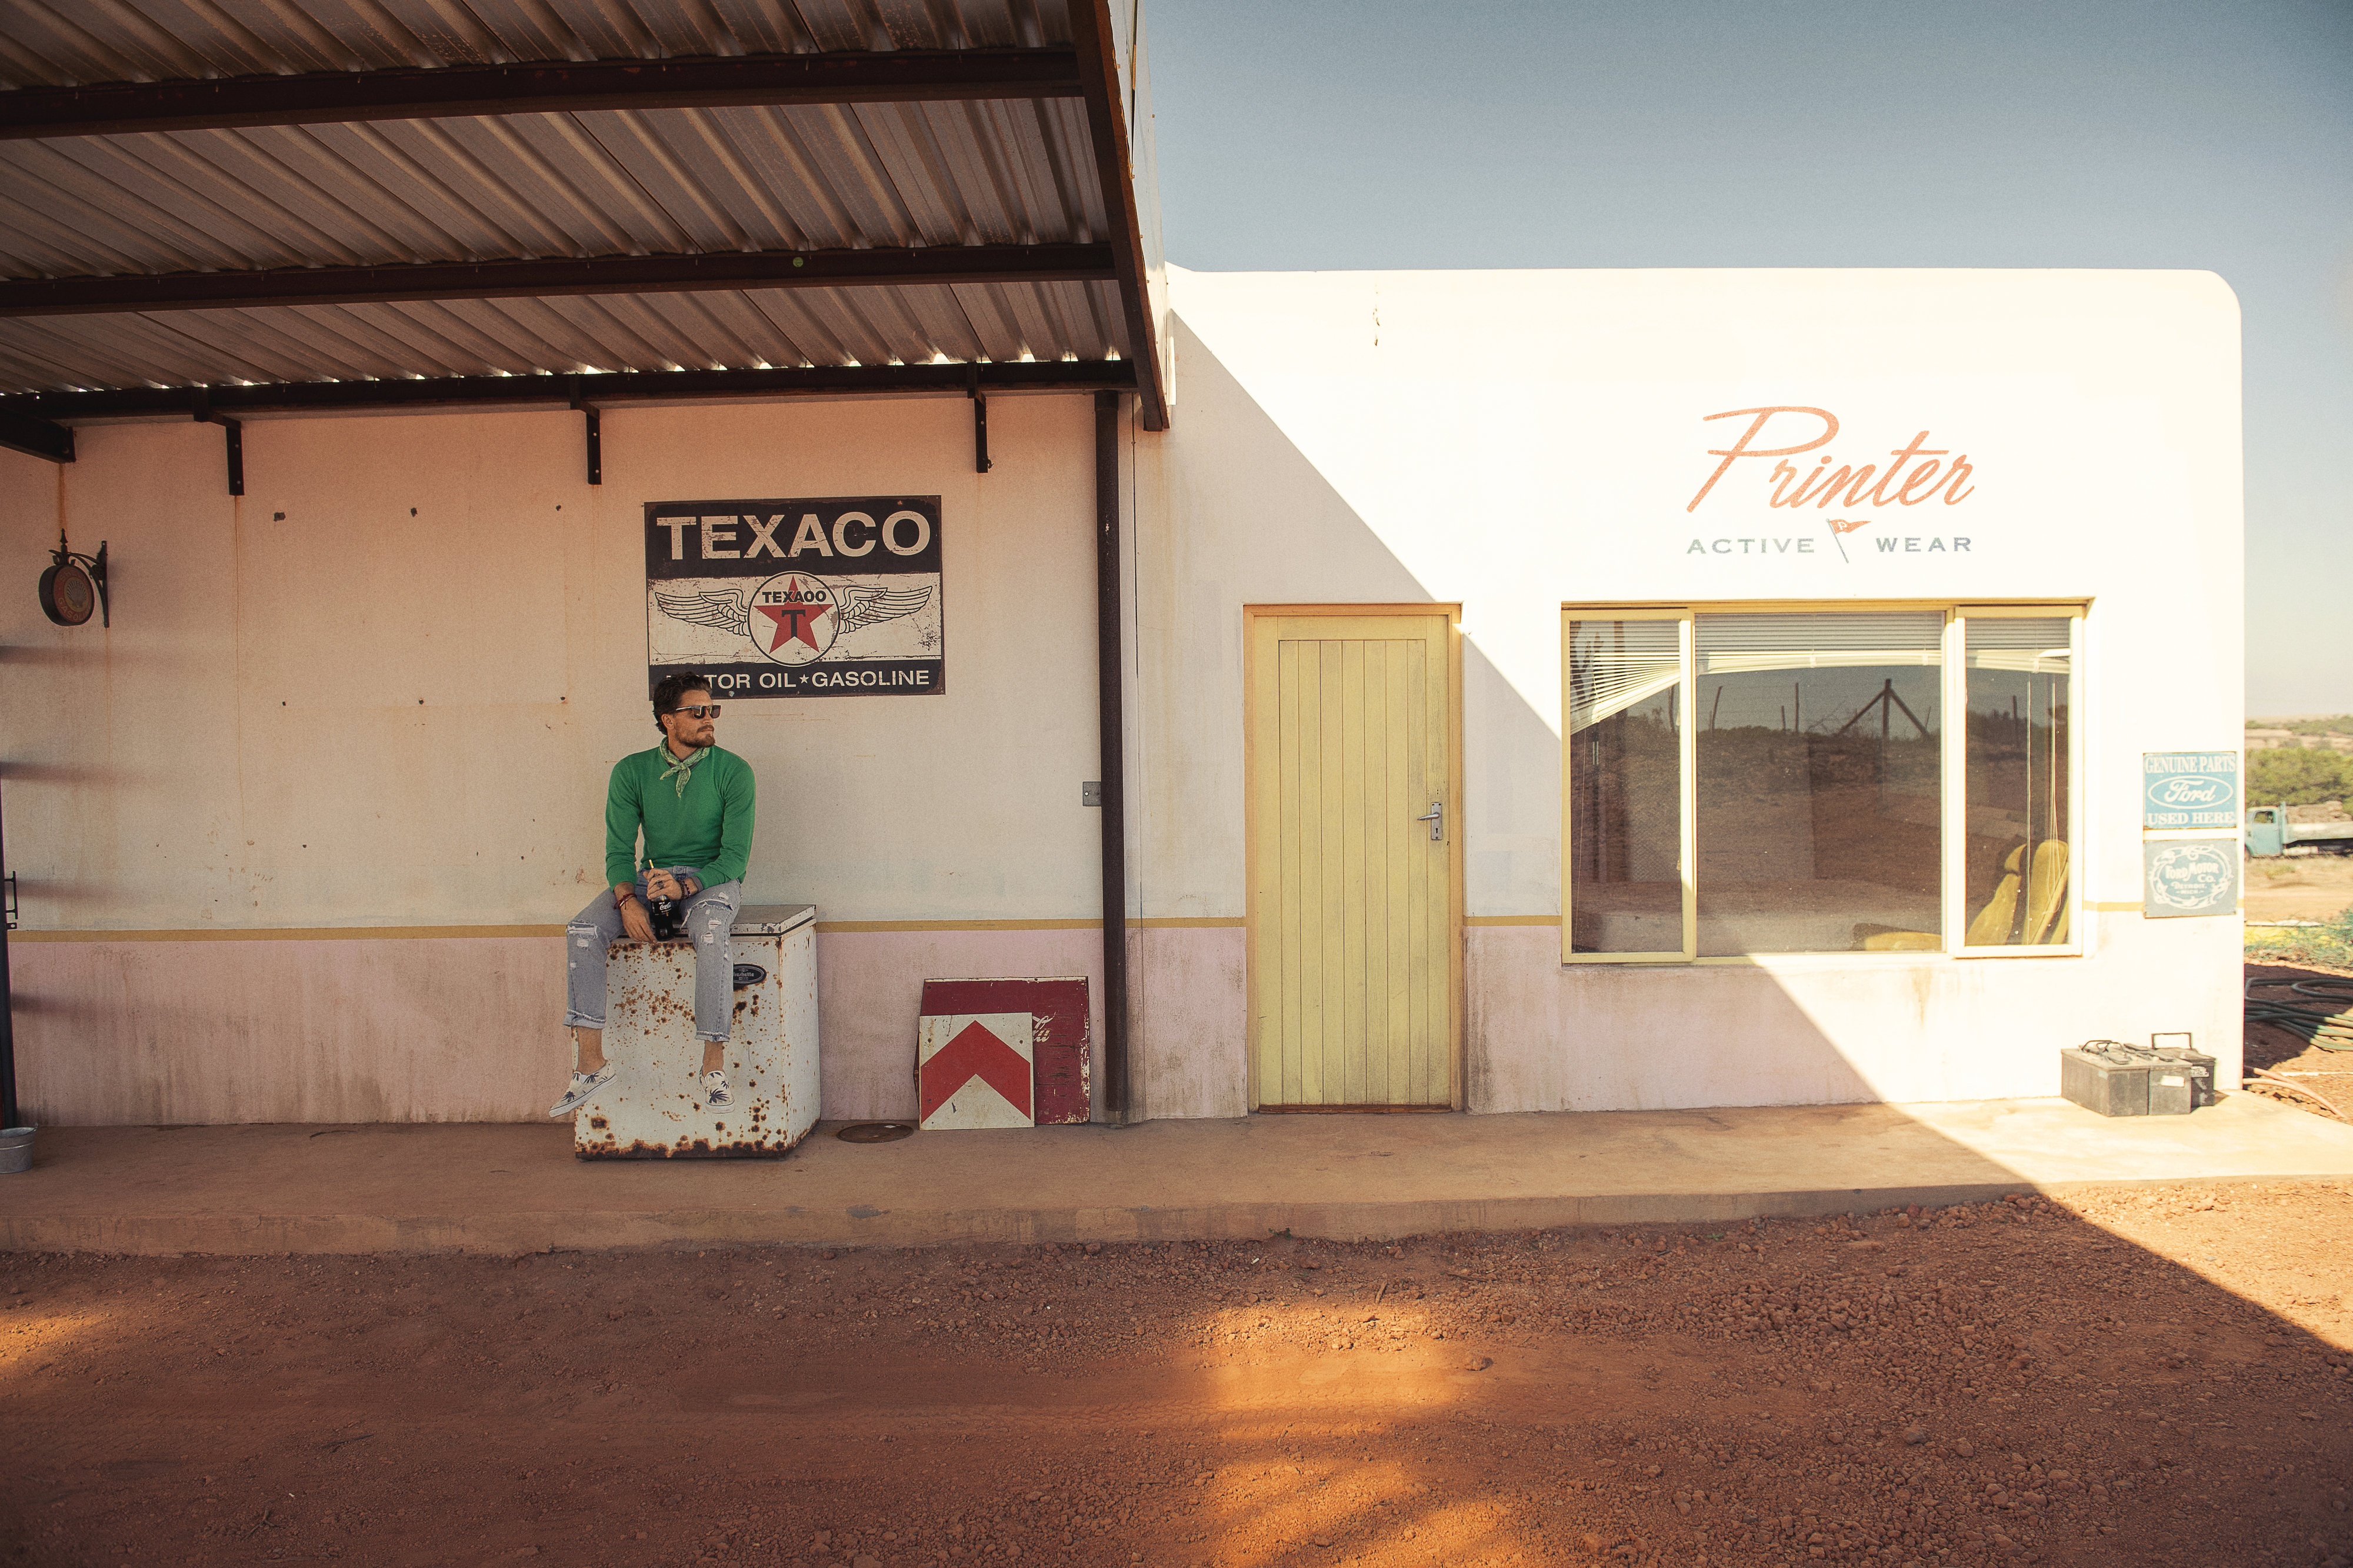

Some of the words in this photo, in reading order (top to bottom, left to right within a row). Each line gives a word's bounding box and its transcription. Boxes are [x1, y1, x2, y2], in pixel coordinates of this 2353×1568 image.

[1687, 406, 1975, 513] Printer
[656, 511, 931, 560] TEXACO
[1687, 538, 1814, 554] ACTIVE
[1876, 537, 1972, 552] WEAR
[781, 609, 806, 638] T
[666, 673, 751, 689] TOR
[759, 673, 796, 688] OIL
[812, 670, 929, 687] GASOLINE
[2146, 756, 2198, 773] GENUINE
[2199, 755, 2236, 773] PARTS
[2164, 779, 2217, 802] Ford
[2147, 812, 2189, 825] USED
[2192, 812, 2235, 824] HERE
